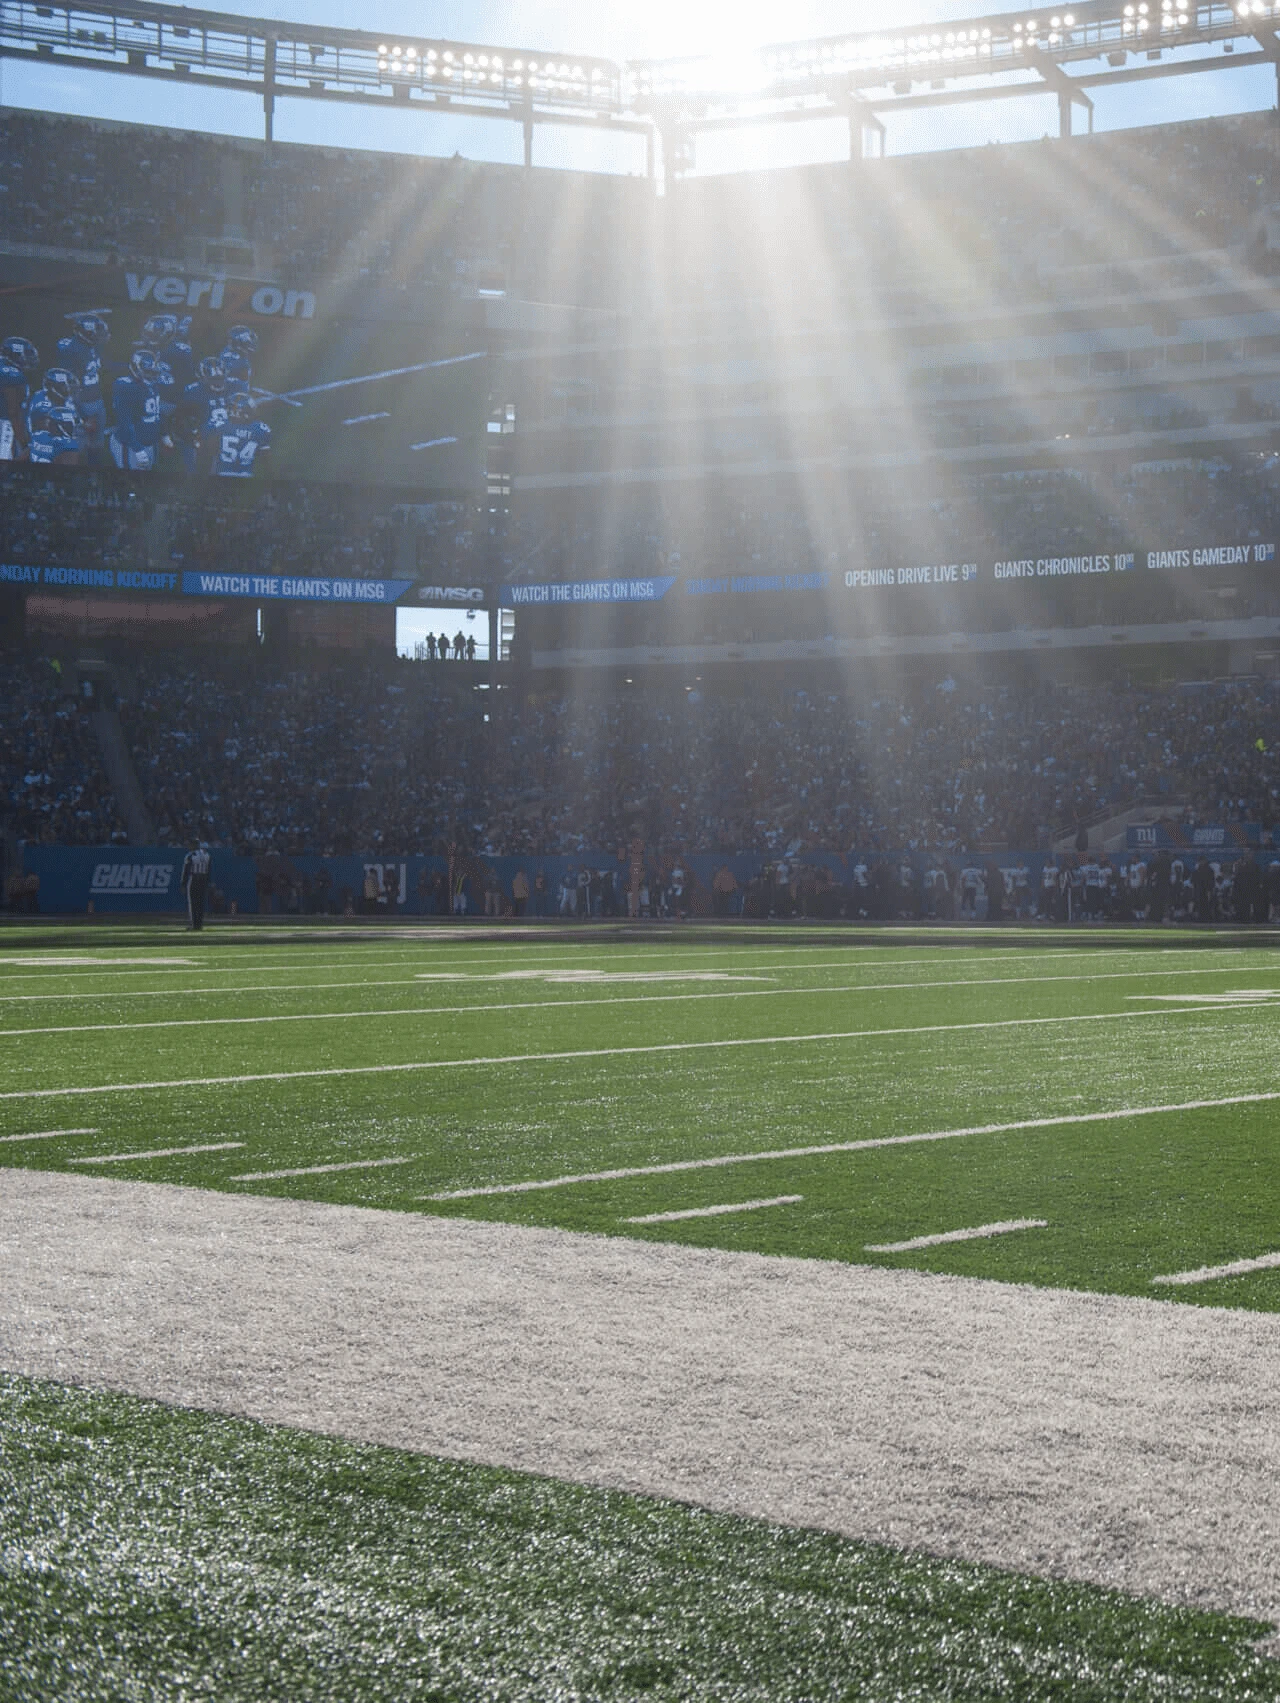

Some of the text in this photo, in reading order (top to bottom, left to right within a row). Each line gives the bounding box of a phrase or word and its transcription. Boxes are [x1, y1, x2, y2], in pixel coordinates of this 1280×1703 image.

[125, 272, 315, 319] verizon
[220, 435, 257, 465] 54
[994, 560, 1034, 579] GIANTS
[1036, 554, 1110, 576] CHRONICLES
[1147, 549, 1190, 568] GIANTS
[1192, 545, 1250, 566] GAMEDAY
[44, 567, 113, 588] MORNING
[117, 571, 177, 590] KICKOFF
[200, 575, 385, 599] WATCH THE GIANTS ON MSG
[845, 567, 894, 587] OPENING
[897, 565, 932, 584] DRIVE
[933, 564, 960, 582] LIVE
[433, 586, 484, 600] MSG
[512, 580, 654, 602] WATCH THE GIANTS ON MSG
[91, 863, 174, 888] GIANTS
